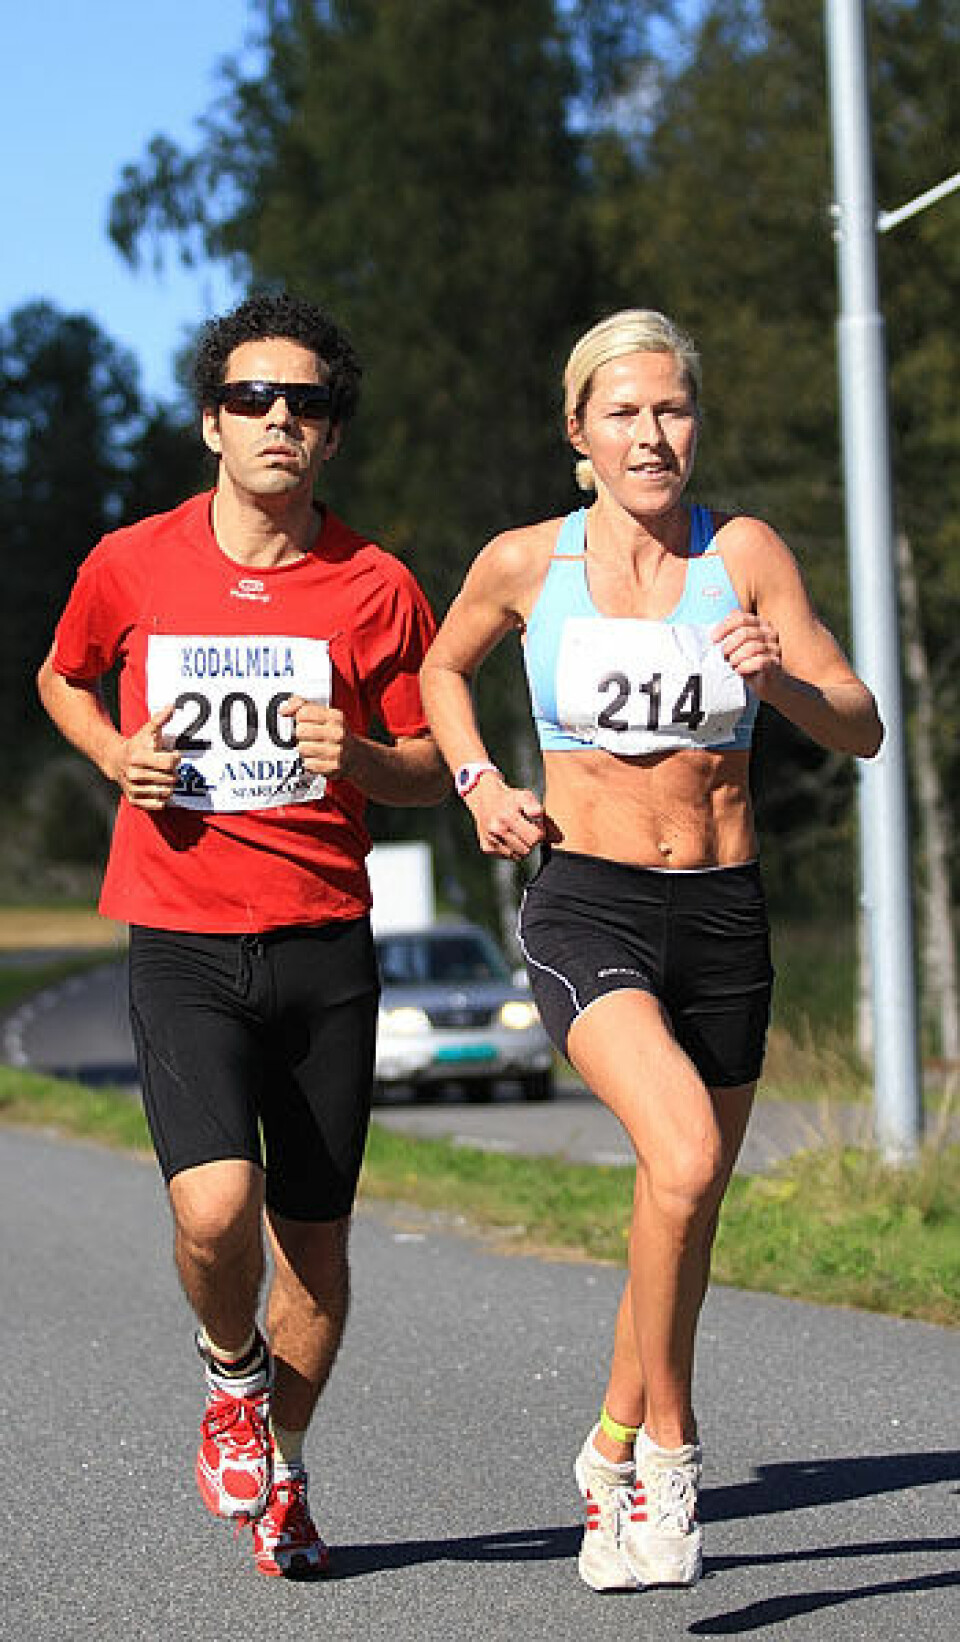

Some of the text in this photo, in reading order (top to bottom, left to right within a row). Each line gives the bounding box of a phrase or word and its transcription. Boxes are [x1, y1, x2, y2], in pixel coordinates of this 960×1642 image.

[180, 646, 295, 679] KODALMILA
[174, 691, 300, 750] 200
[597, 671, 705, 731] 214
